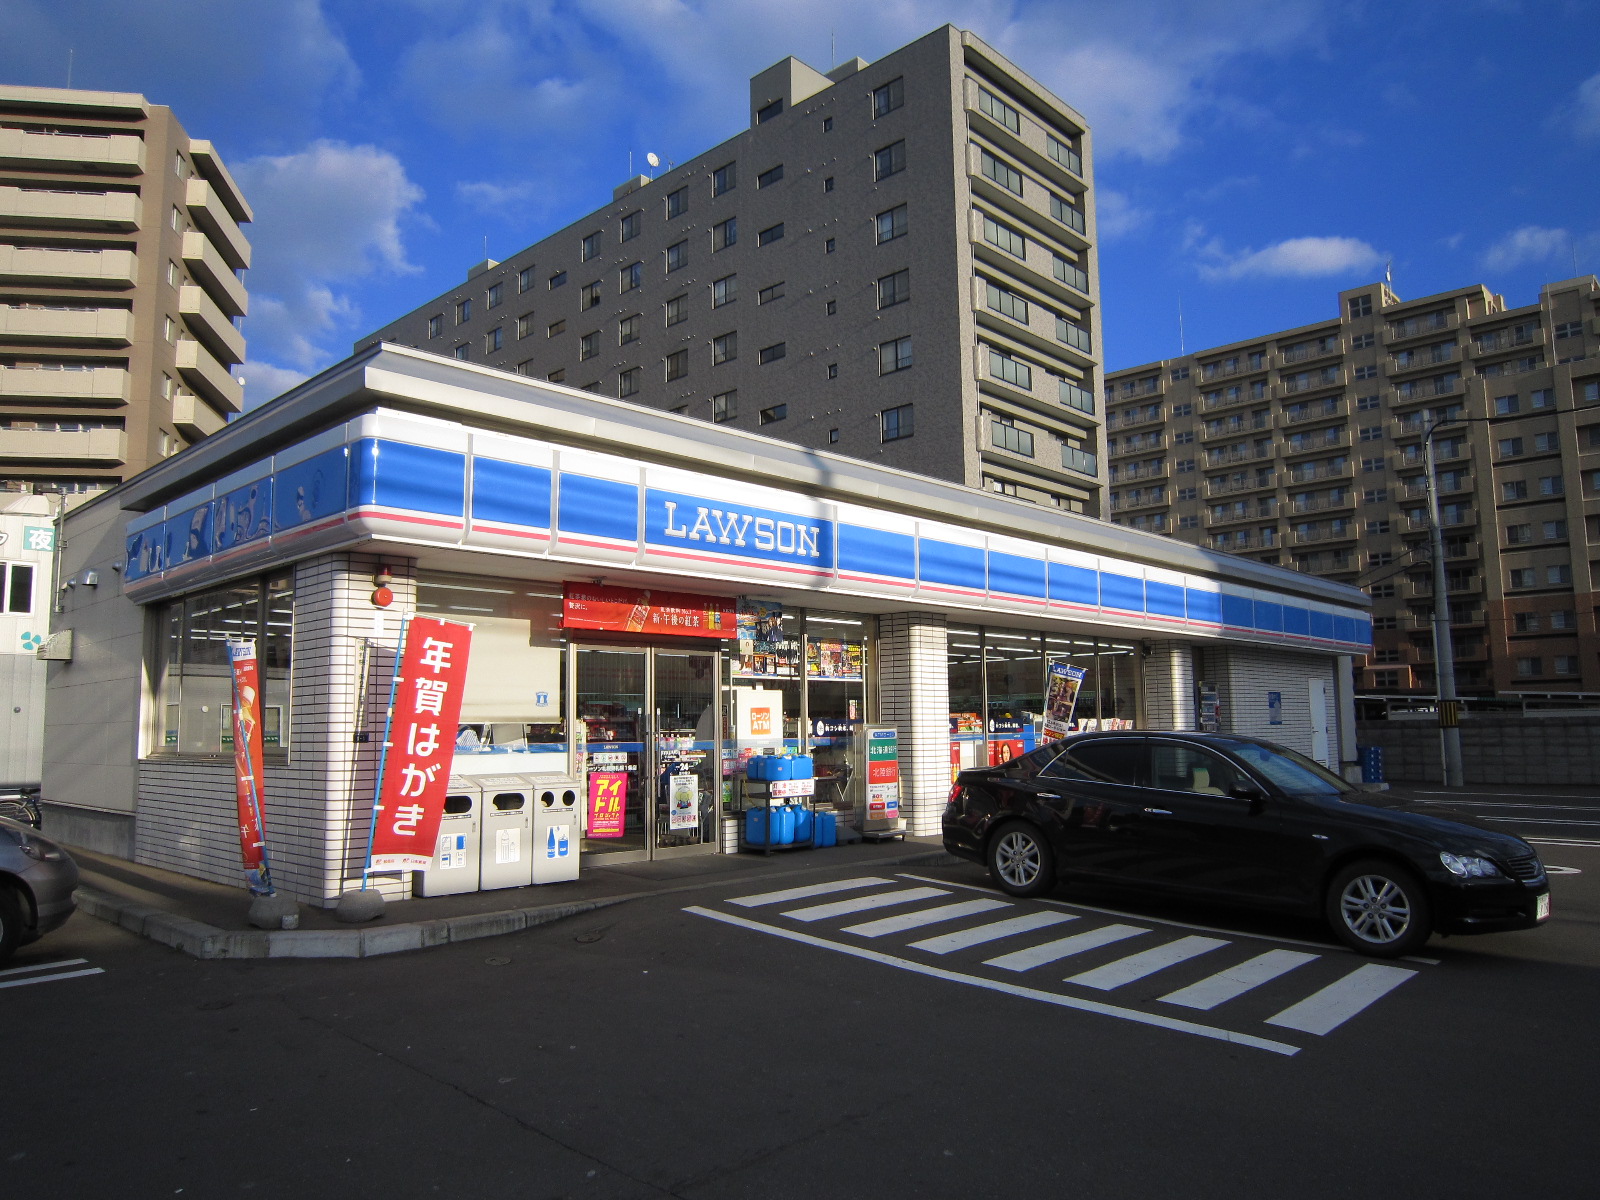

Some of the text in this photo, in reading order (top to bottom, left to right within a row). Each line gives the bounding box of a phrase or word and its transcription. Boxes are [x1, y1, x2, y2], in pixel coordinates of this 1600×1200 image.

[664, 500, 820, 558] LAWSON
[28, 529, 53, 551] 夜
[751, 712, 770, 720] ローソン
[752, 721, 770, 730] ATM
[392, 636, 455, 837] 年賀はがき
[869, 745, 897, 755] 北海道銀行
[680, 762, 689, 771] 24
[872, 766, 896, 778] 北陸銀行
[595, 779, 623, 796] アイ
